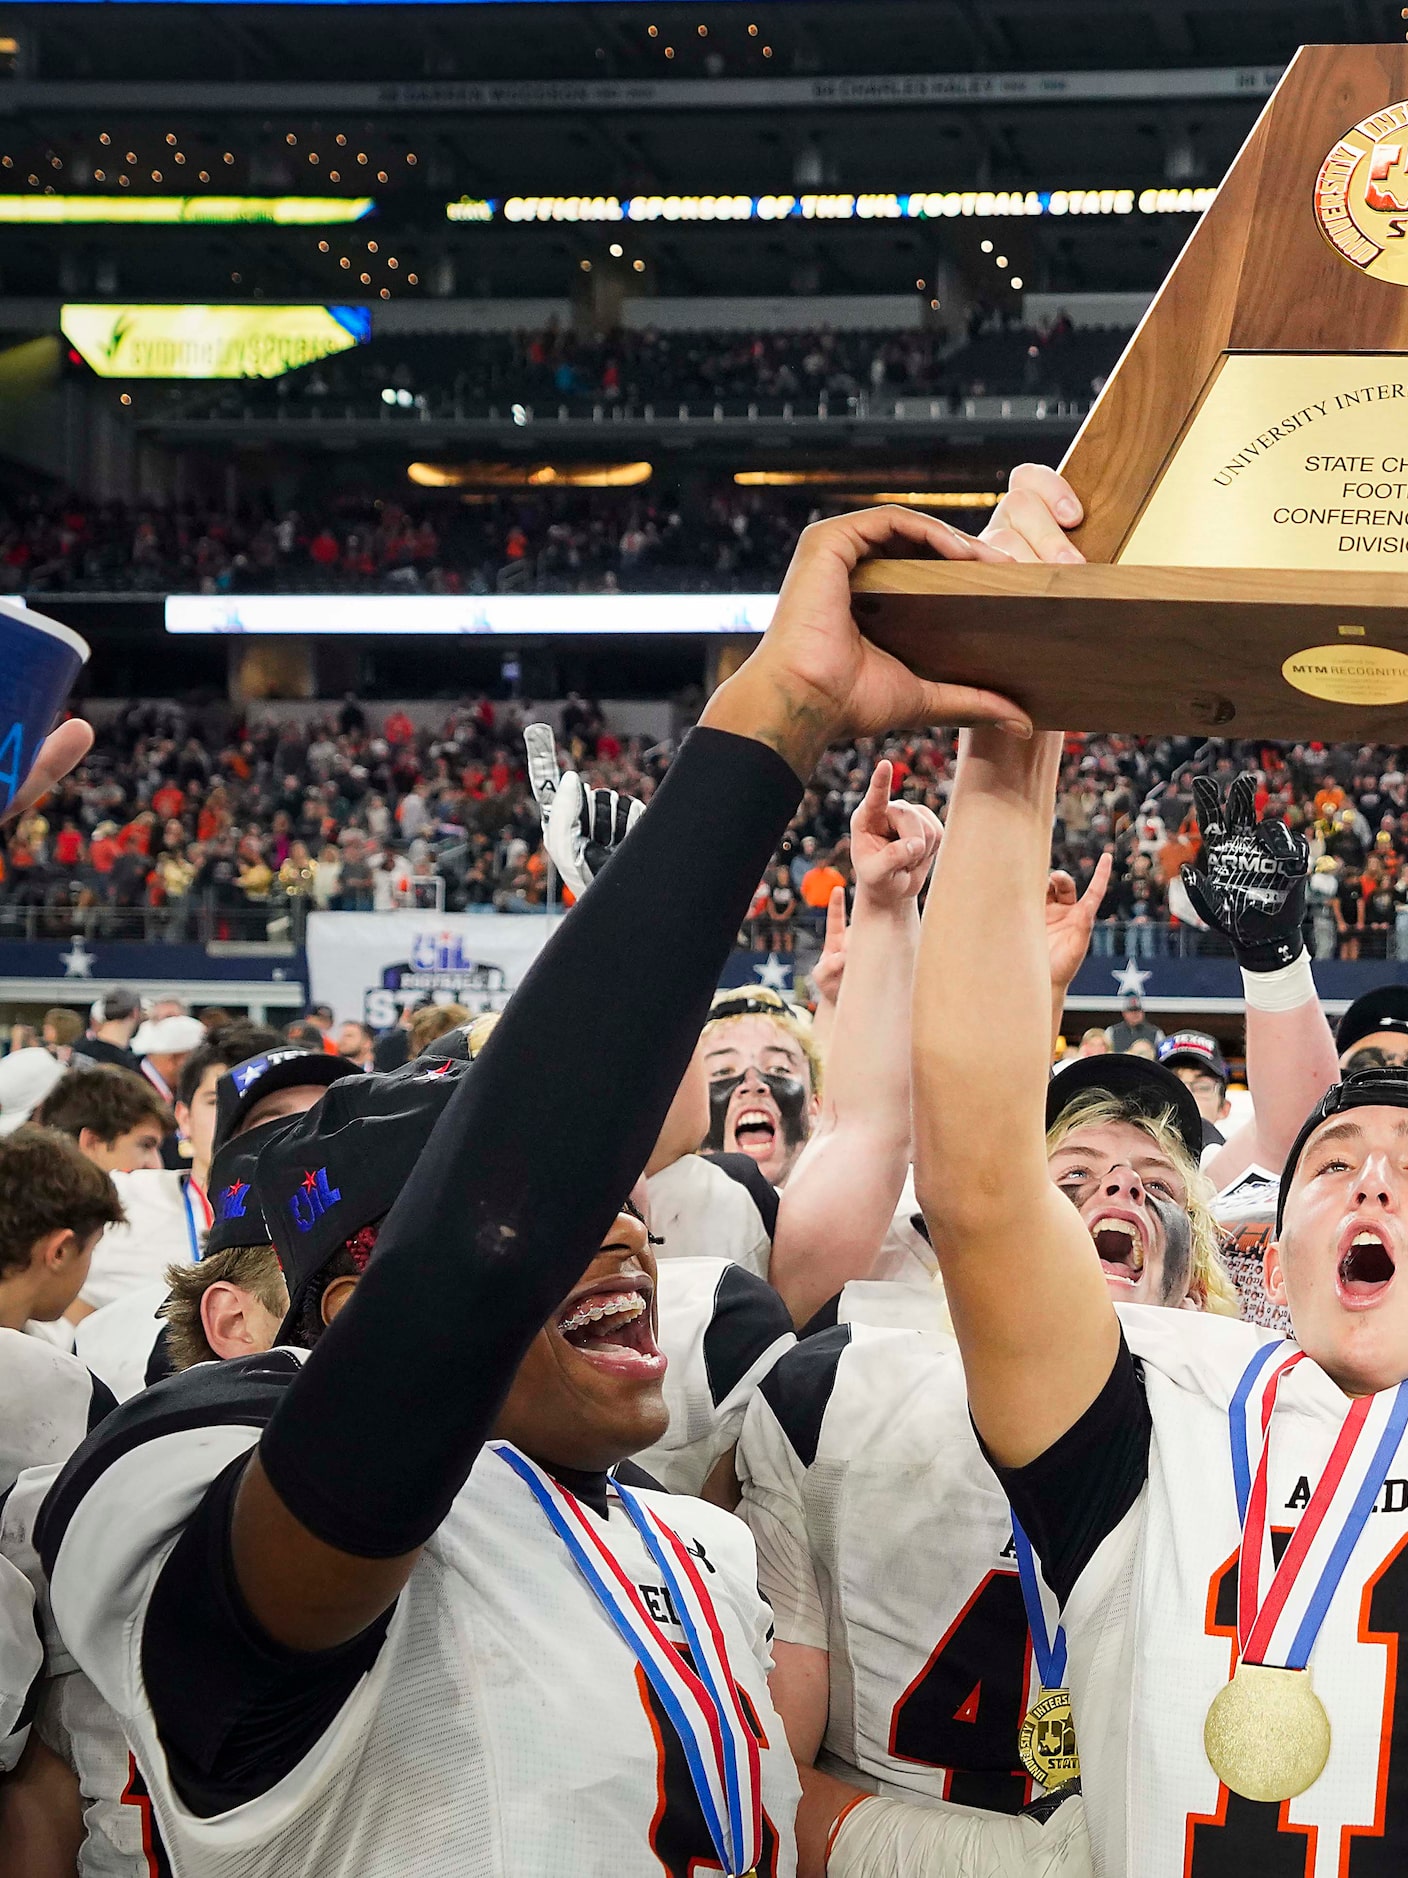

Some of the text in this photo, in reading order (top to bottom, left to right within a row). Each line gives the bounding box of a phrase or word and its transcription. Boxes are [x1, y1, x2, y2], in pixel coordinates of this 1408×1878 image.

[1319, 144, 1380, 266] UNIVERSITY
[1213, 400, 1329, 488] UNIVERSITY
[1304, 455, 1376, 474] STATE
[1292, 664, 1329, 675] MTM
[411, 931, 471, 970] UIL
[289, 1166, 342, 1233] UIL
[1038, 1711, 1076, 1757] UI
[1048, 1758, 1080, 1769] STAT
